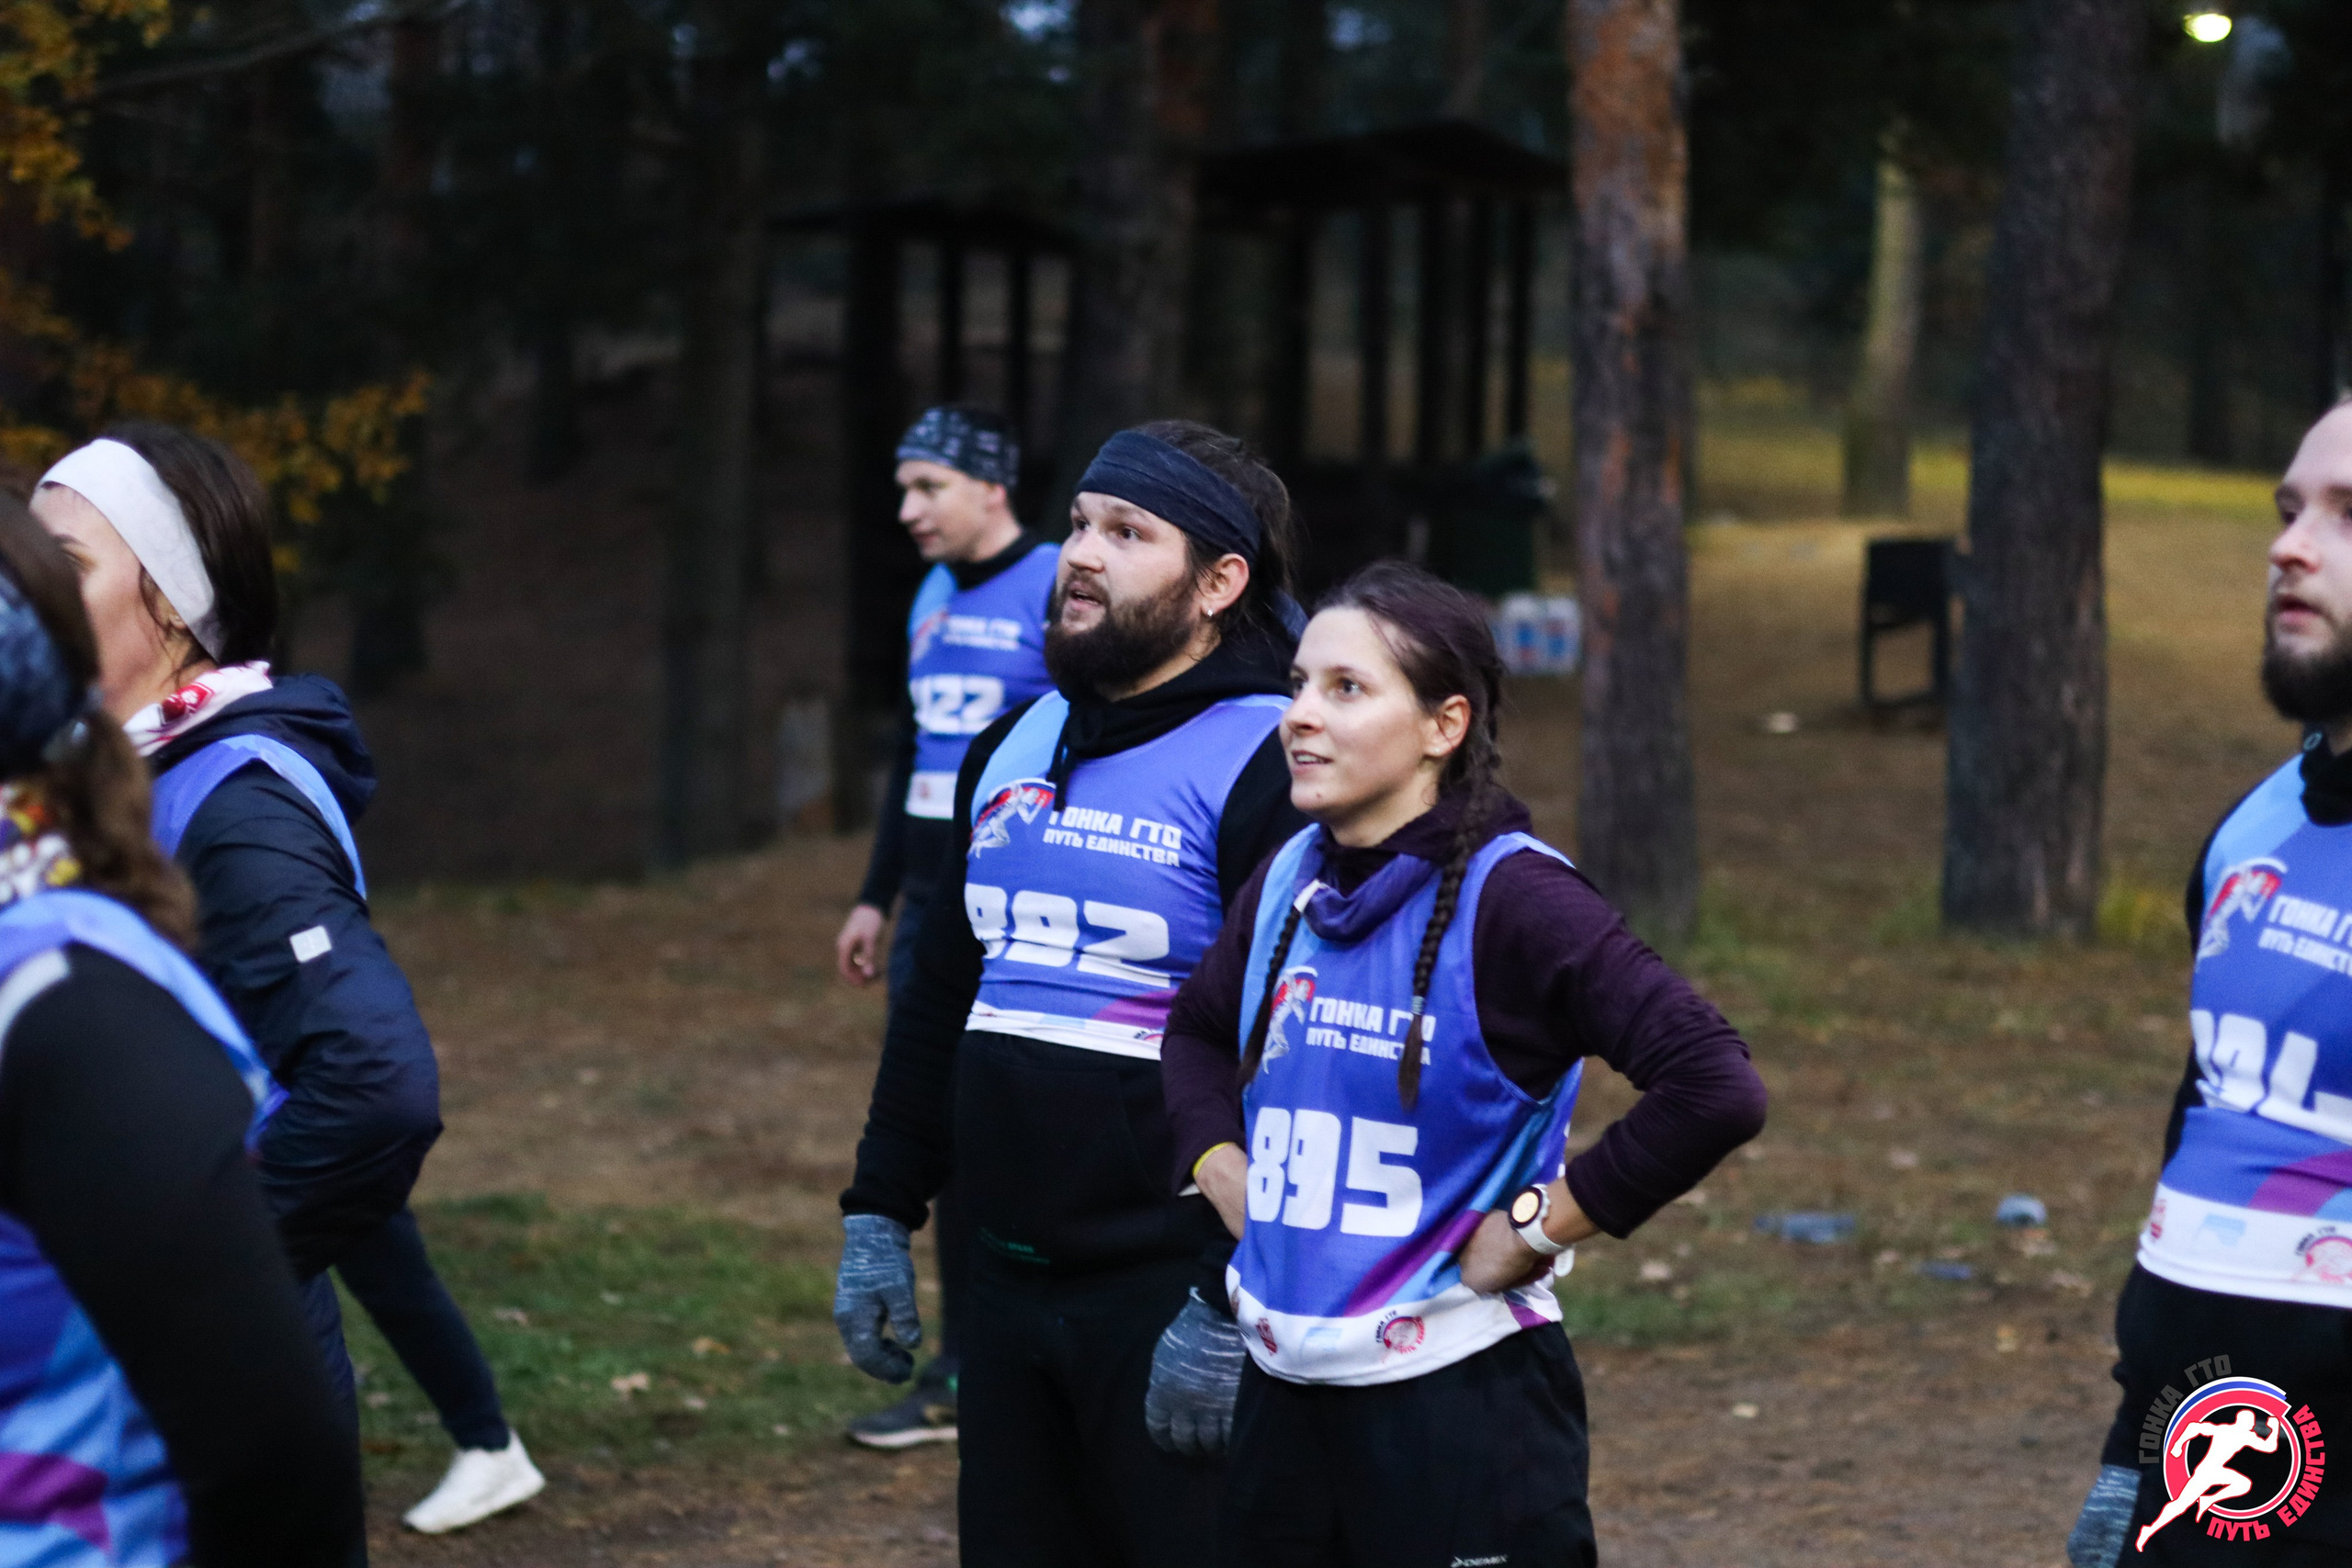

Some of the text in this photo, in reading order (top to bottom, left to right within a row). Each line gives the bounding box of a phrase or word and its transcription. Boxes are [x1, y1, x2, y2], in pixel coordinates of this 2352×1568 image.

[1042, 828, 1181, 868] ПУТЬ ЕДИНСТВА
[1129, 817, 1182, 851] ГТО
[964, 882, 1170, 988] 892
[1308, 996, 1385, 1034] ГОНКА
[1305, 1026, 1431, 1066] ПУТЬ ЕДИНСА
[1246, 1105, 1424, 1238] 895
